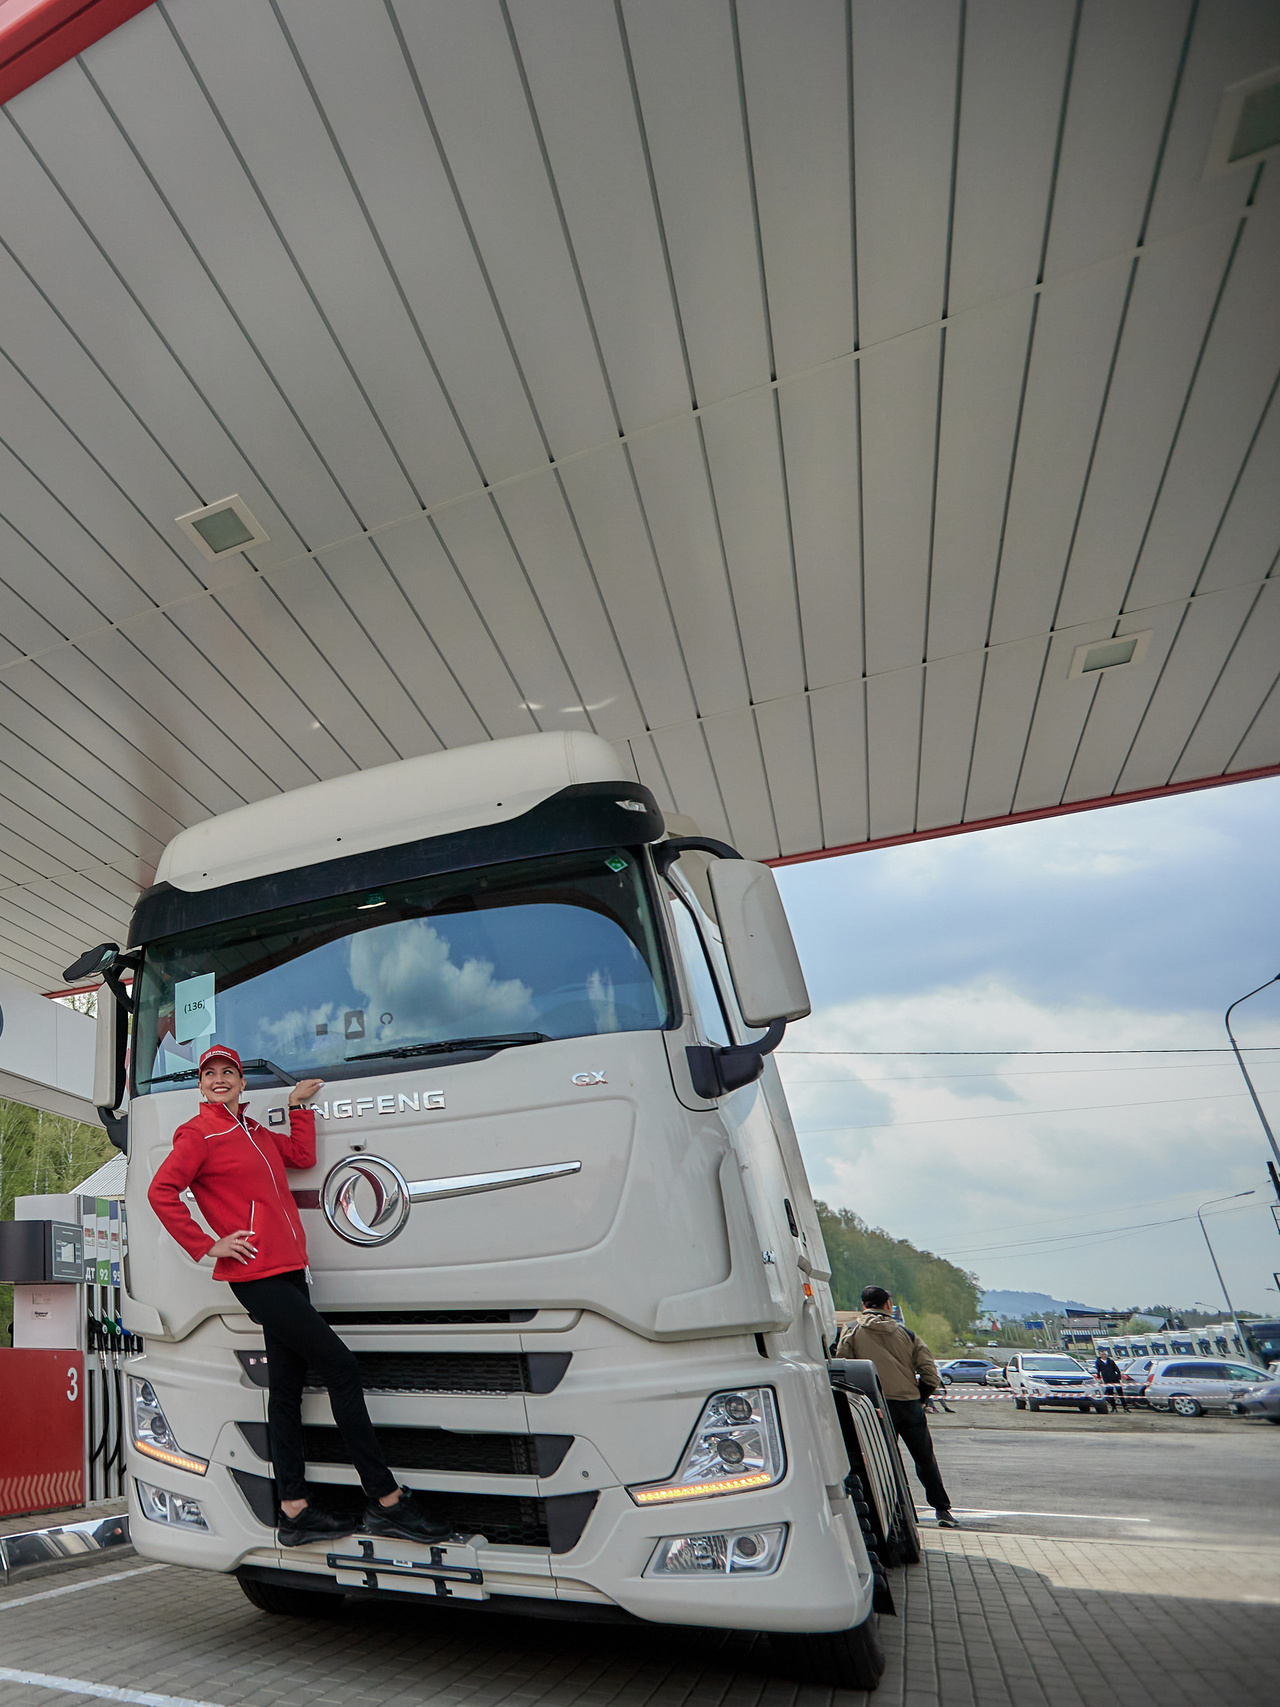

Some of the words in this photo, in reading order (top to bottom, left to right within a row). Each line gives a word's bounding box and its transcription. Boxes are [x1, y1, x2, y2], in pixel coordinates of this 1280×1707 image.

[184, 999, 205, 1014] (136)
[571, 1069, 608, 1086] GX
[267, 1090, 446, 1127] DNGFENG
[85, 1266, 95, 1281] ДТ
[99, 1268, 108, 1281] 92
[112, 1270, 120, 1282] 95
[67, 1367, 78, 1402] 3
